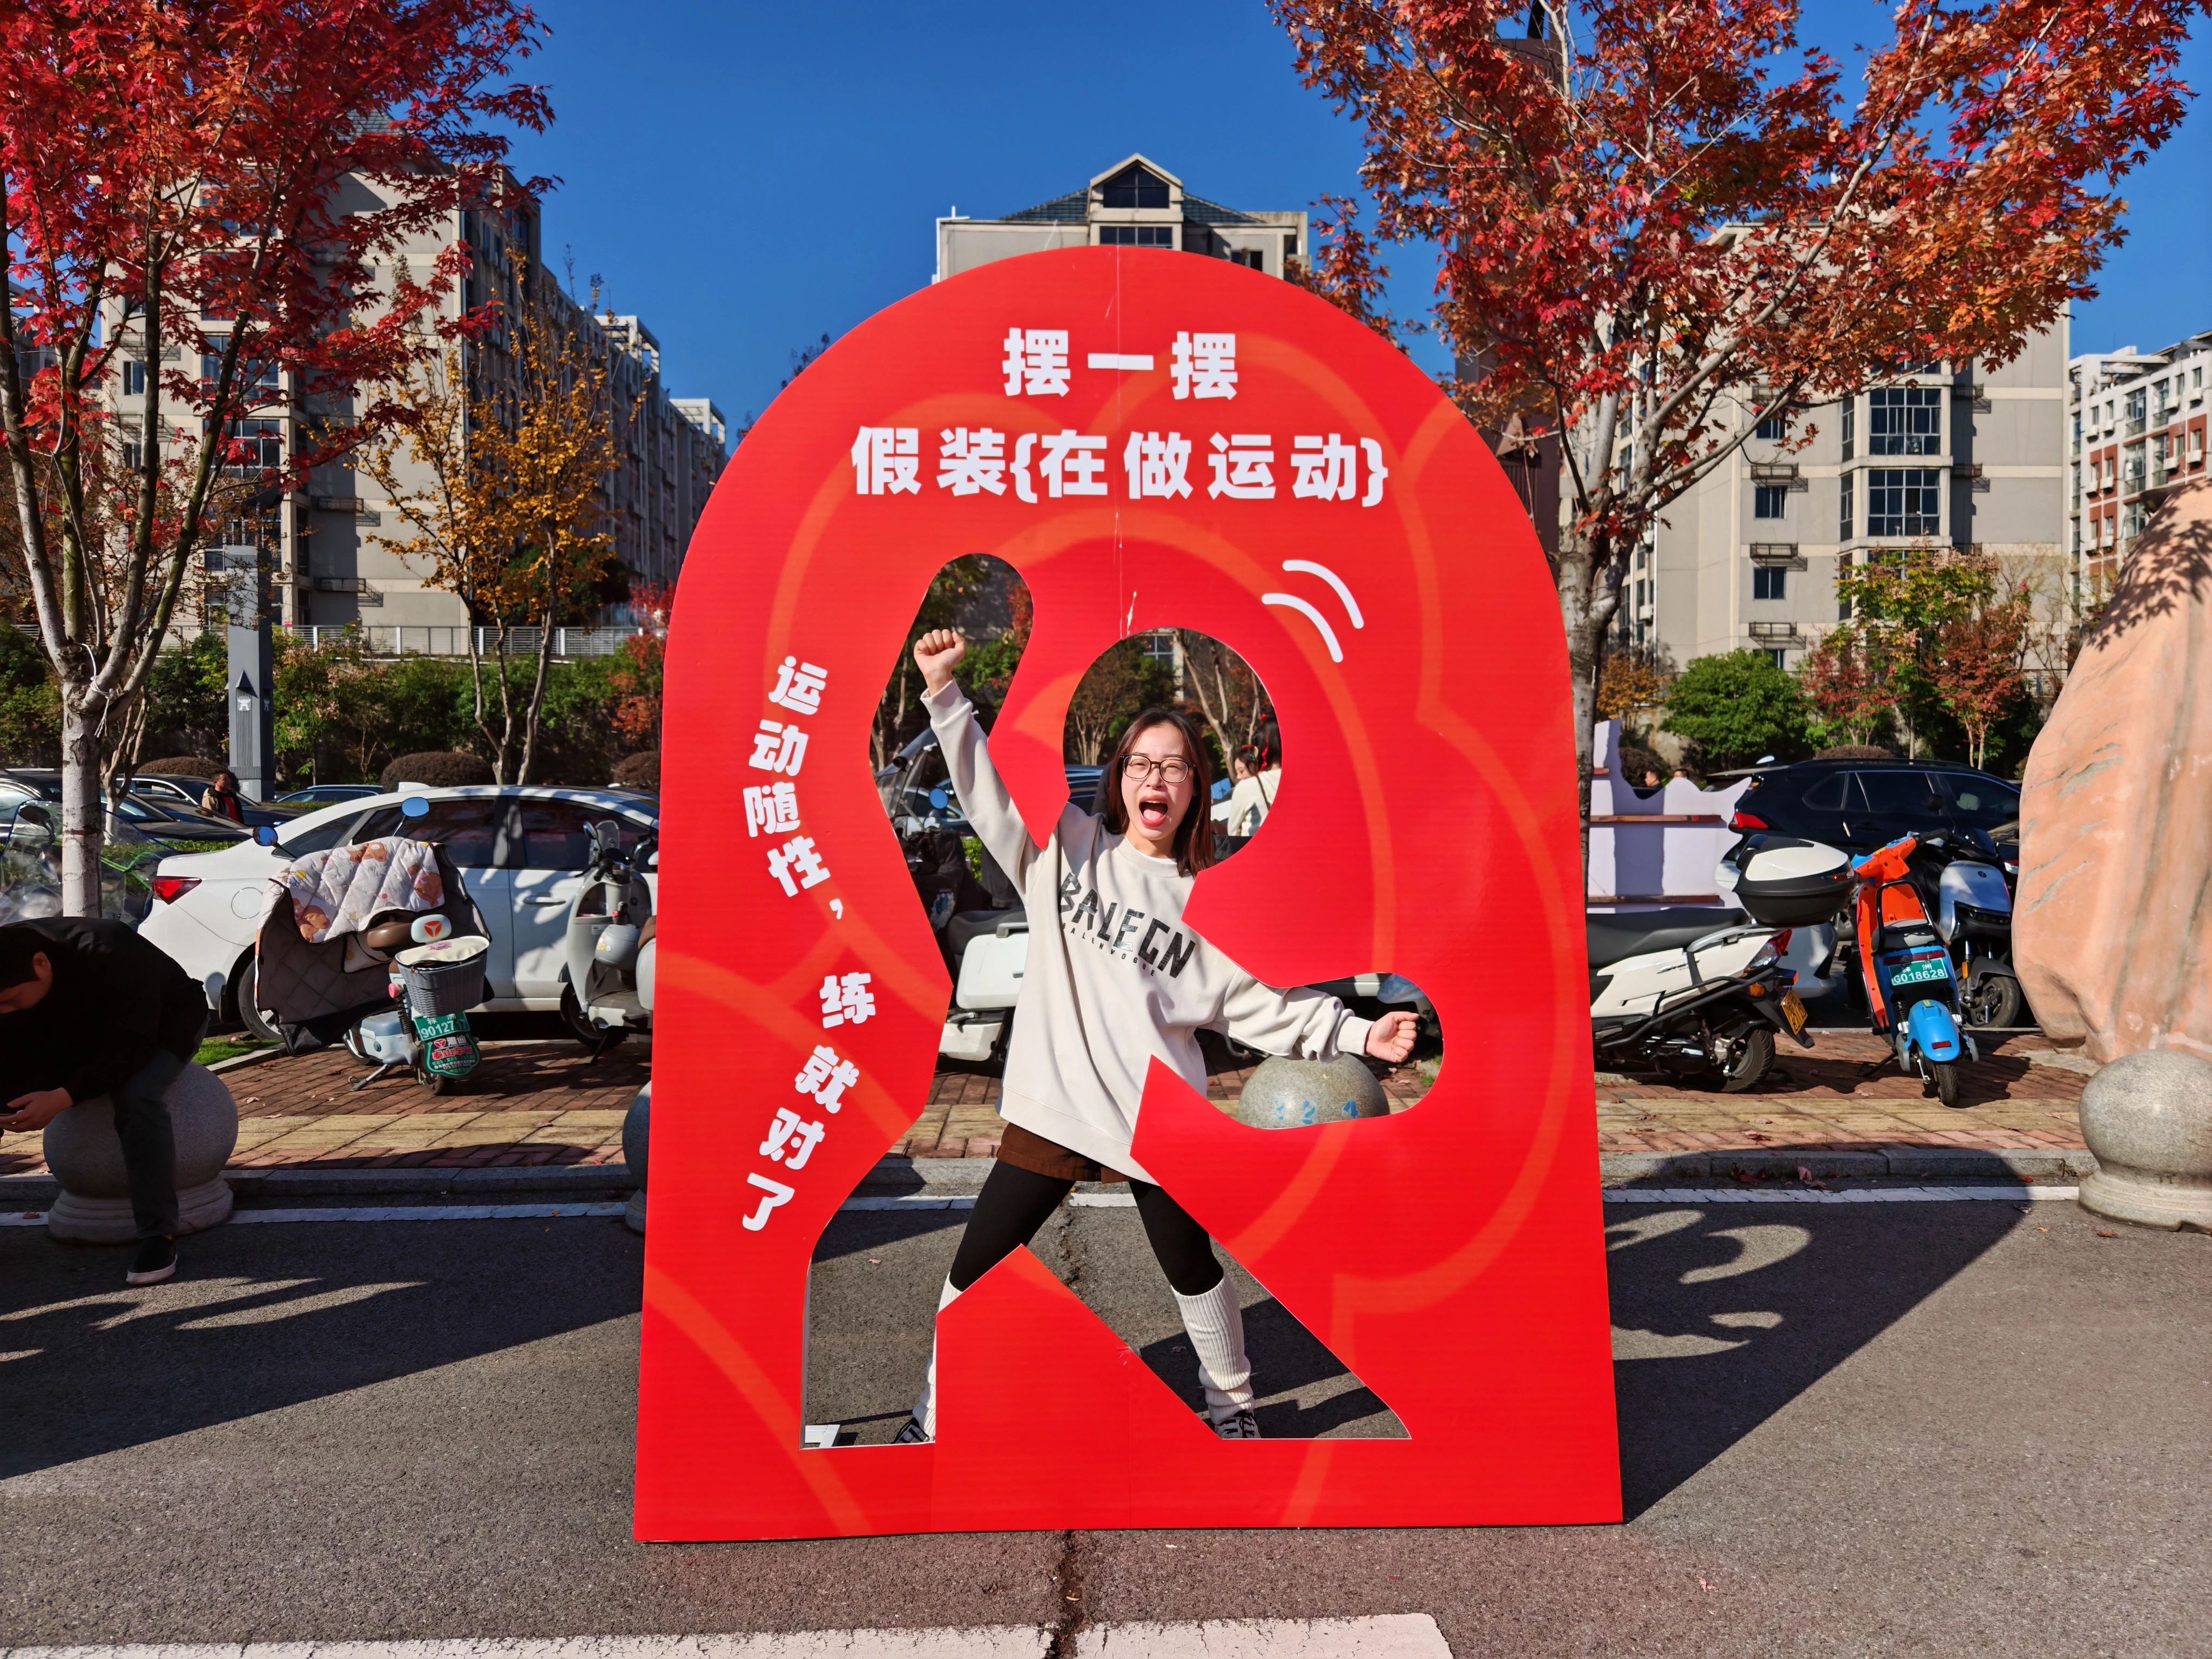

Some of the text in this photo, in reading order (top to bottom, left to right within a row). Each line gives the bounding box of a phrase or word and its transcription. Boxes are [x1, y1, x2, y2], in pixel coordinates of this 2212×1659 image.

[1002, 327, 1238, 400] 摆一摆
[851, 426, 1388, 507] 假装{在做运动}
[1062, 922, 1155, 976] BALENVOGUE
[1893, 969, 1945, 983] G018628
[421, 1019, 467, 1038] 9012717
[743, 972, 876, 1231] 练就对了
